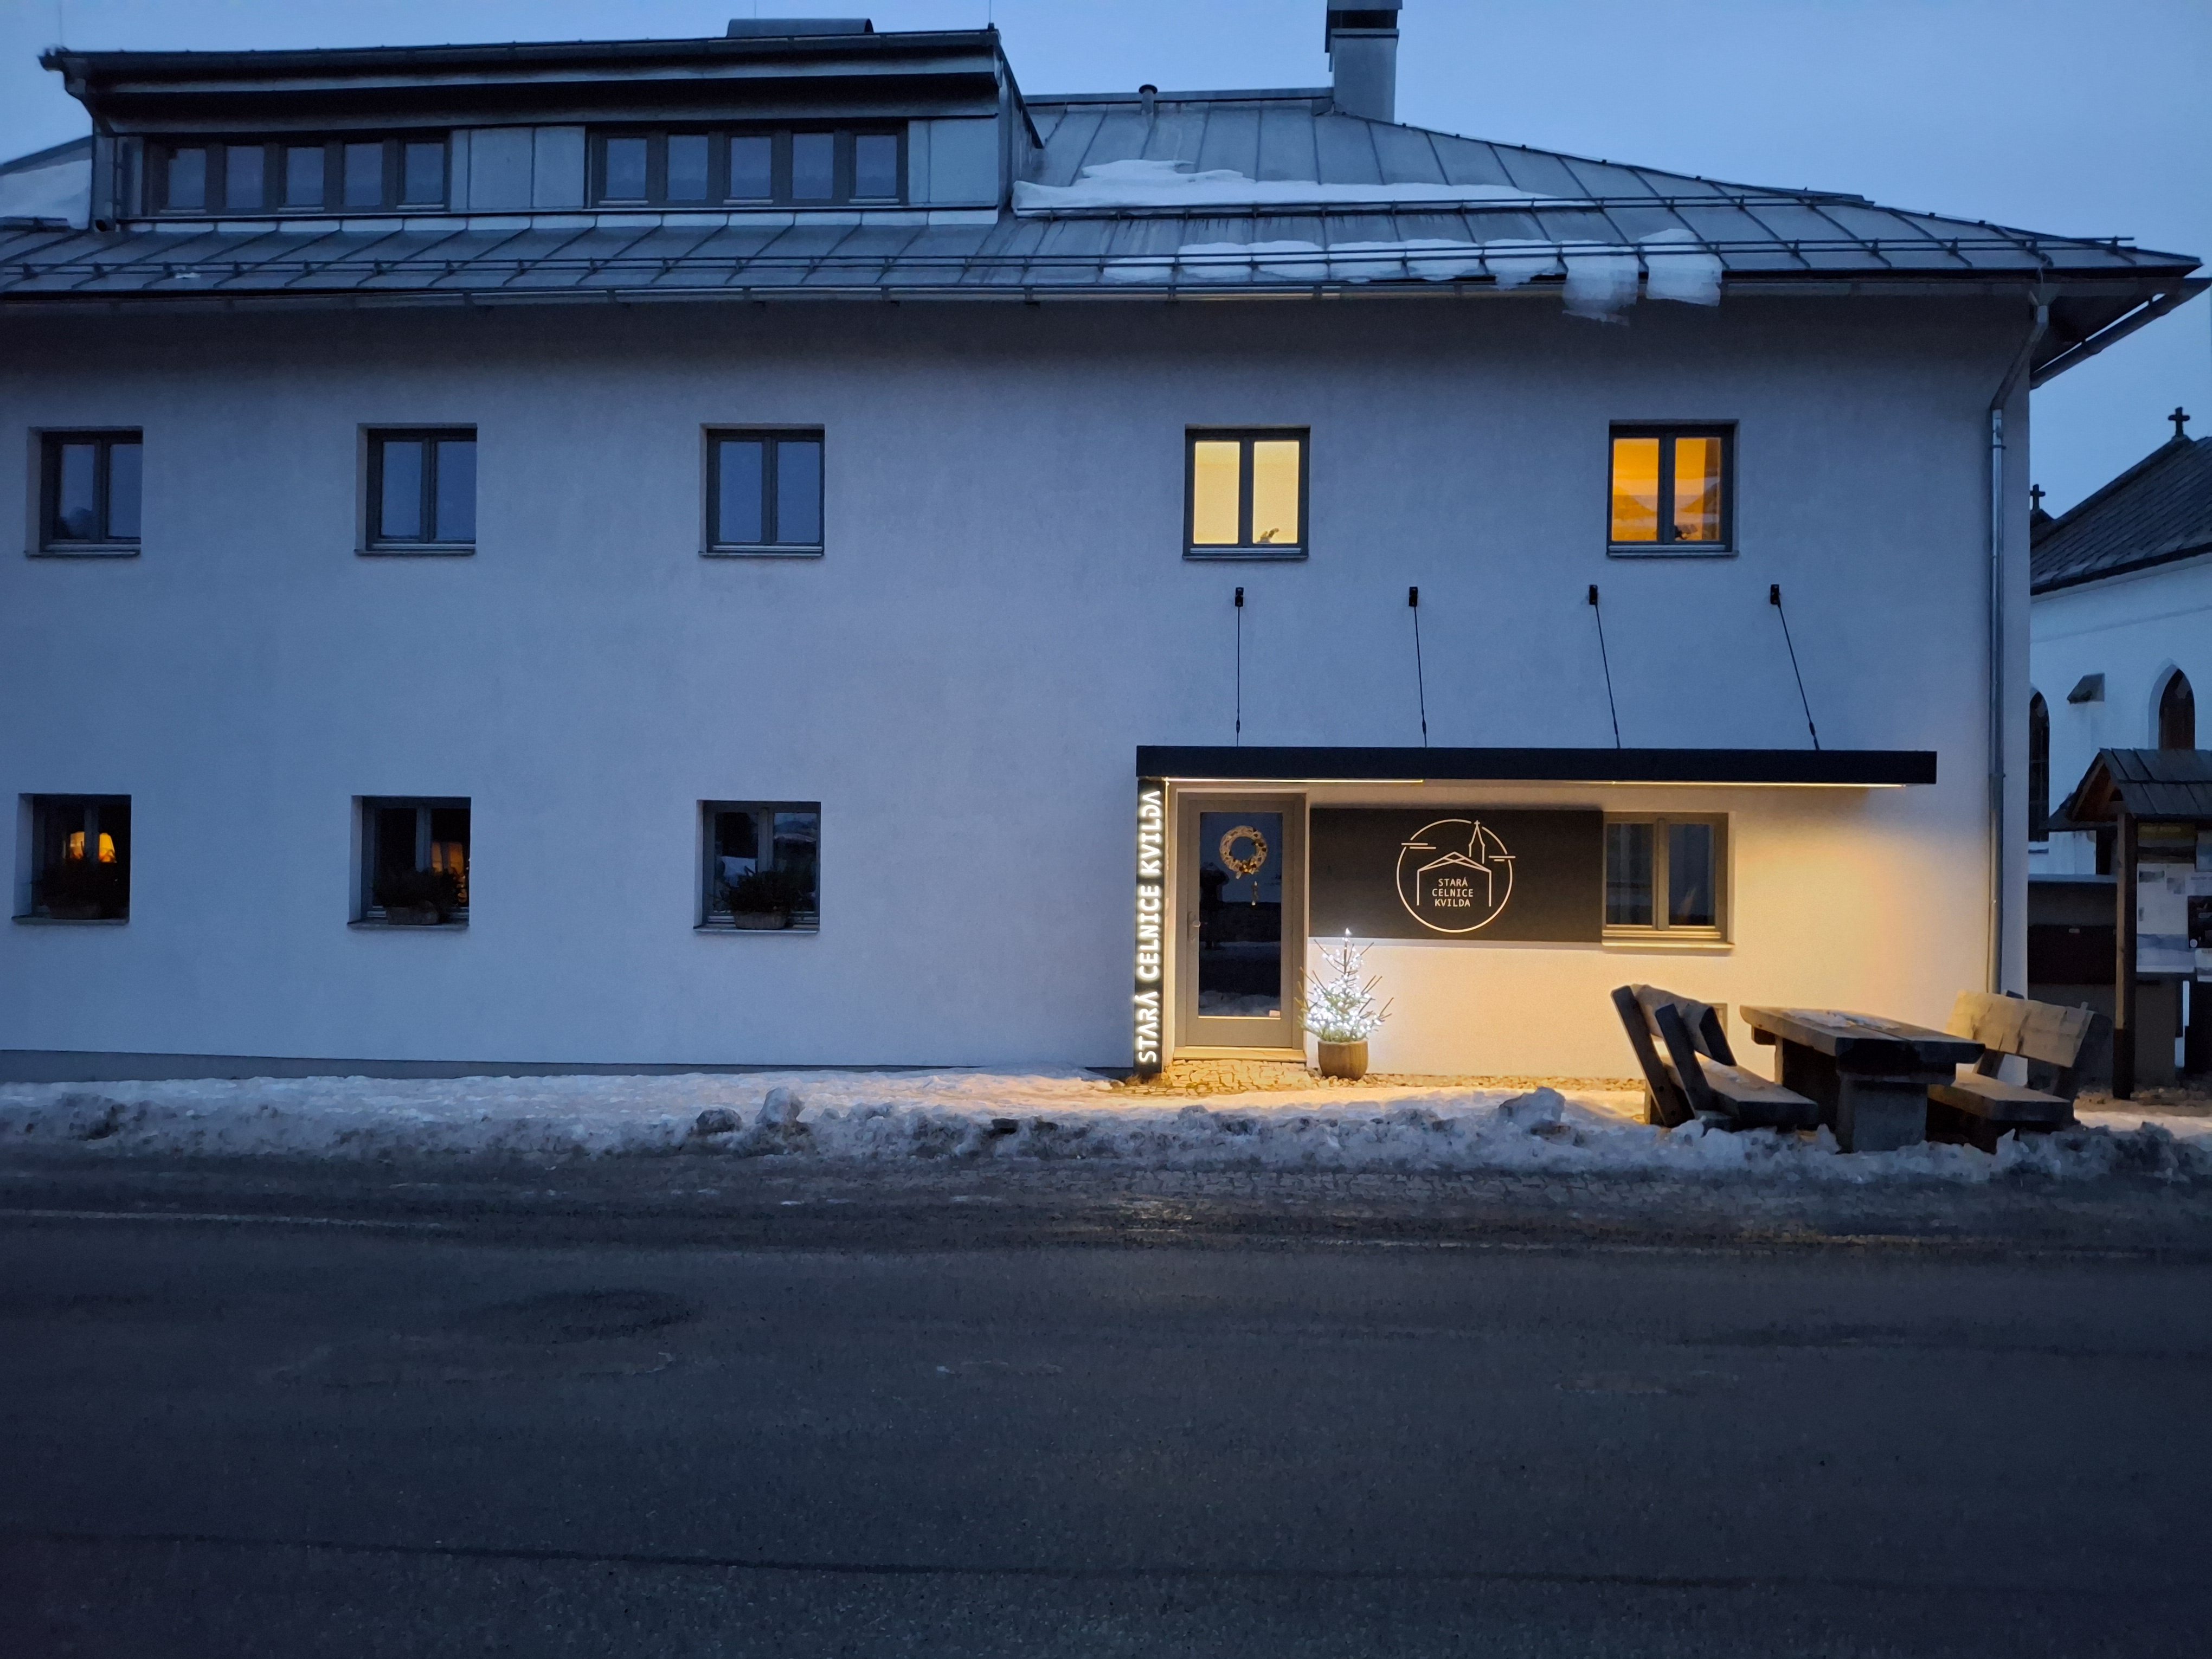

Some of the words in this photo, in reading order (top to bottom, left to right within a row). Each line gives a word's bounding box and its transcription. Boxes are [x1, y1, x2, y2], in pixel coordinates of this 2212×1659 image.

[1140, 790, 1161, 876] KVILDA
[1432, 888, 1474, 897] CELNICE
[1435, 898, 1471, 907] KVILDA
[1438, 877, 1468, 887] STARÁ
[1138, 885, 1159, 981] CELNICE
[1136, 991, 1158, 1063] STARÁ
